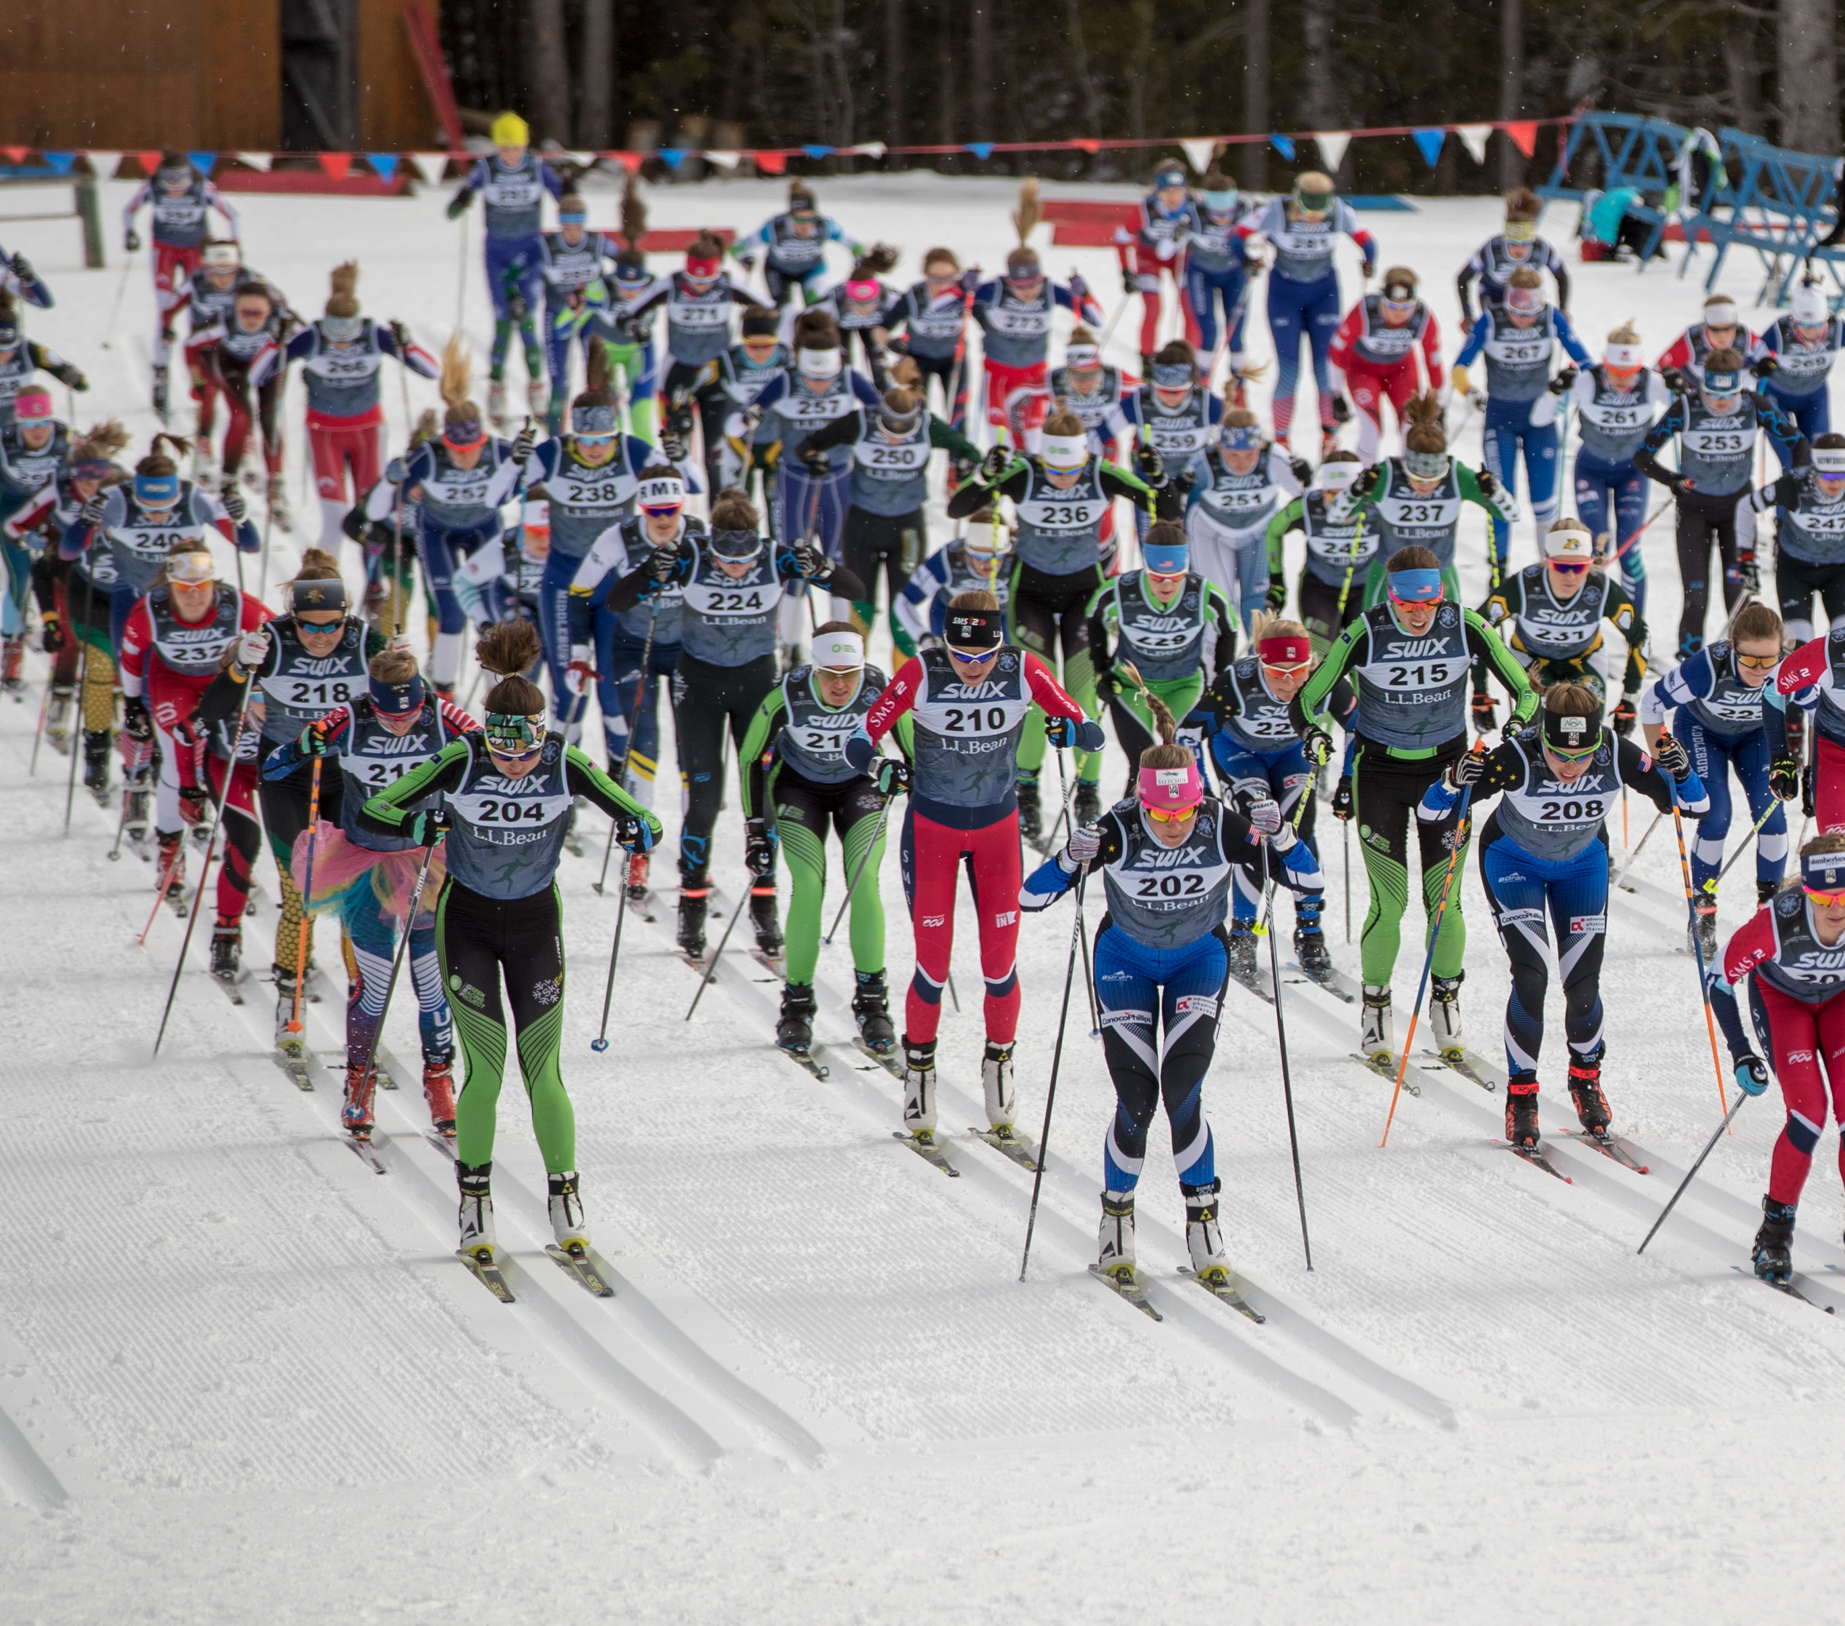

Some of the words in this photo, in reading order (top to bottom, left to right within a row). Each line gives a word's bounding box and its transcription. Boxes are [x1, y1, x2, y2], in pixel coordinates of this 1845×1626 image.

[1505, 345, 1541, 359] 267
[327, 361, 367, 374] 266
[1790, 356, 1826, 368] 269
[798, 402, 839, 416] 257
[1601, 409, 1637, 424] 261
[1696, 416, 1746, 431] SWIX
[1154, 434, 1195, 449] 259
[1700, 435, 1742, 450] 253
[872, 449, 916, 465] 250
[1216, 473, 1262, 490] SWIX
[568, 483, 618, 502] 238
[1221, 493, 1263, 507] 251
[1041, 505, 1090, 525] 236
[1399, 505, 1445, 523] 237
[136, 532, 183, 549] 240
[1323, 542, 1369, 555] 245
[707, 592, 764, 612] 224
[701, 615, 768, 627] L.L.Bean
[952, 616, 969, 626] SMS
[1134, 614, 1193, 632] SWIX
[1531, 608, 1591, 626] SWIX
[166, 627, 227, 643] SWIX
[555, 588, 570, 668] MIDDLEBURY
[1534, 628, 1585, 643] 231
[171, 645, 226, 662] 232
[1381, 636, 1451, 660] SWIX
[288, 655, 351, 677] SWIX
[1388, 663, 1449, 688] 215
[1780, 670, 1801, 690] SMS
[290, 682, 350, 704] 218
[937, 680, 1010, 700] SWIX
[1383, 687, 1452, 706] L.L.Bean
[869, 697, 897, 728] SMS
[944, 707, 1007, 732] 210
[1256, 721, 1298, 736] 22
[361, 733, 429, 755] SWIX
[940, 736, 1008, 755] L.L.Bean
[474, 774, 551, 794] SWIX
[1156, 776, 1188, 786] SALTCHUK
[1536, 774, 1605, 795] SWIX
[477, 800, 546, 823] 204
[1252, 801, 1275, 811] SWIX
[1540, 800, 1605, 821] 208
[472, 826, 548, 847] L.L.Bean
[1132, 846, 1208, 869] SWIX
[1136, 873, 1206, 898] 202
[1728, 955, 1756, 980] SMS
